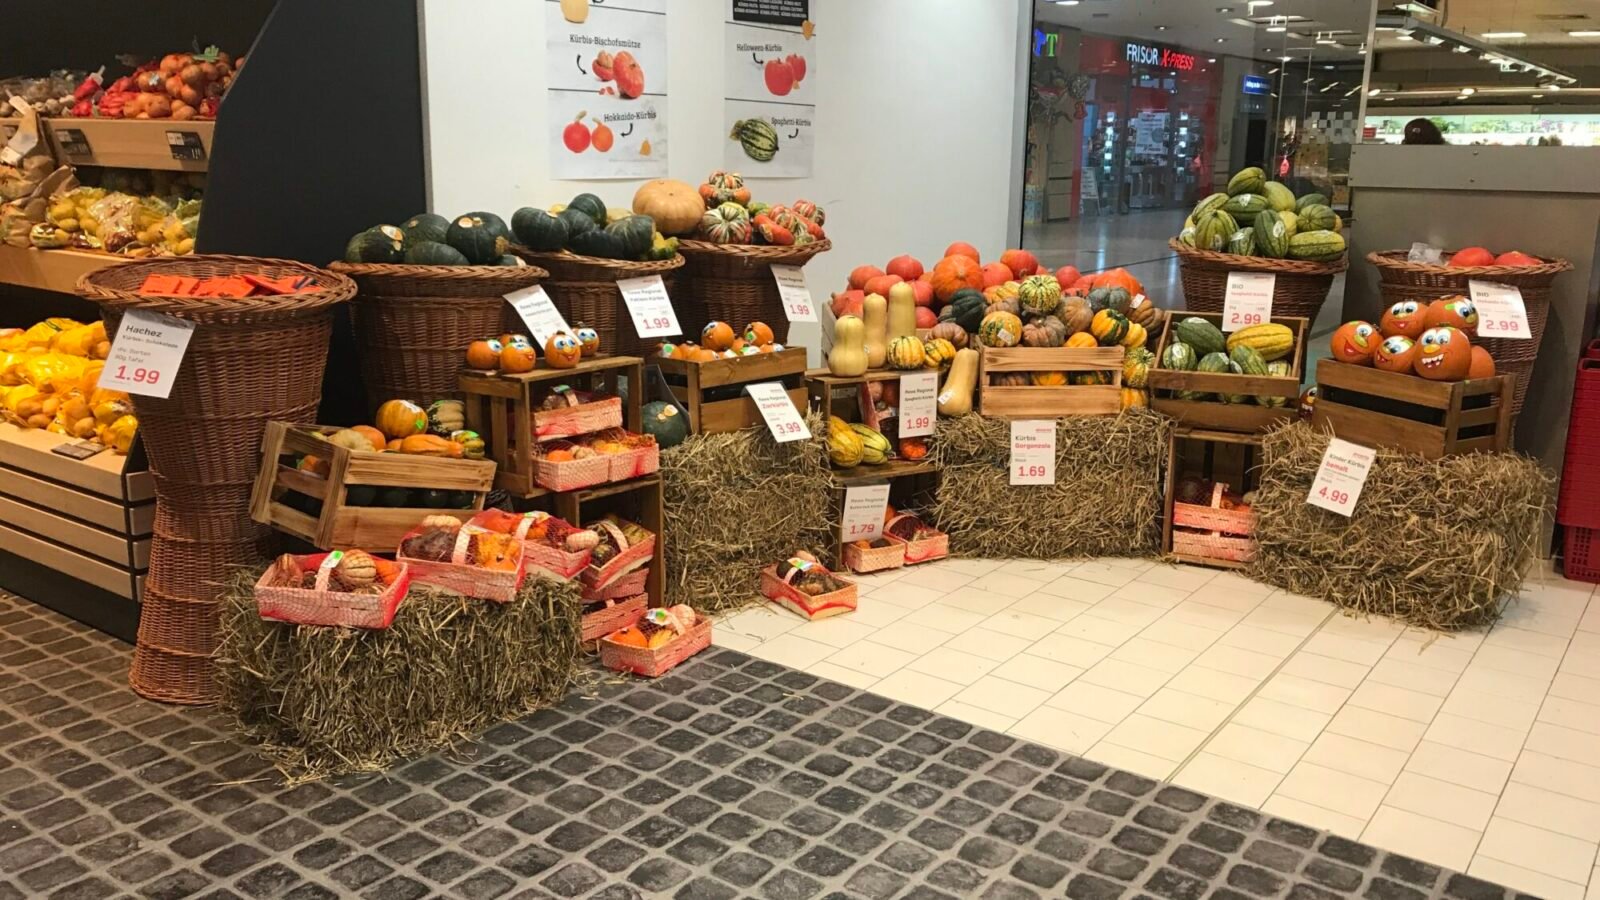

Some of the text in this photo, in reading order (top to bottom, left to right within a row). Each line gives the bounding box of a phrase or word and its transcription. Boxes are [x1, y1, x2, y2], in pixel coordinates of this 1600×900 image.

[569, 33, 641, 49] Kürbis-Bischofsmütze
[1161, 48, 1195, 70] X-PRESS
[604, 111, 657, 122] Hokkaido-Kürbis
[789, 304, 810, 315] 1.99
[643, 317, 671, 330] 1.99
[1231, 312, 1262, 325] 2.99
[1485, 319, 1519, 331] 2.99
[125, 324, 163, 338] Hachez
[114, 364, 161, 385] 1.99
[775, 421, 801, 435] 3.99
[906, 416, 929, 430] 1.99
[1014, 442, 1051, 450] Gorgonzola
[1018, 465, 1046, 477] 1.69
[1325, 461, 1349, 473] bemalt
[1319, 486, 1349, 505] 4.99
[850, 523, 875, 535] 1.79
